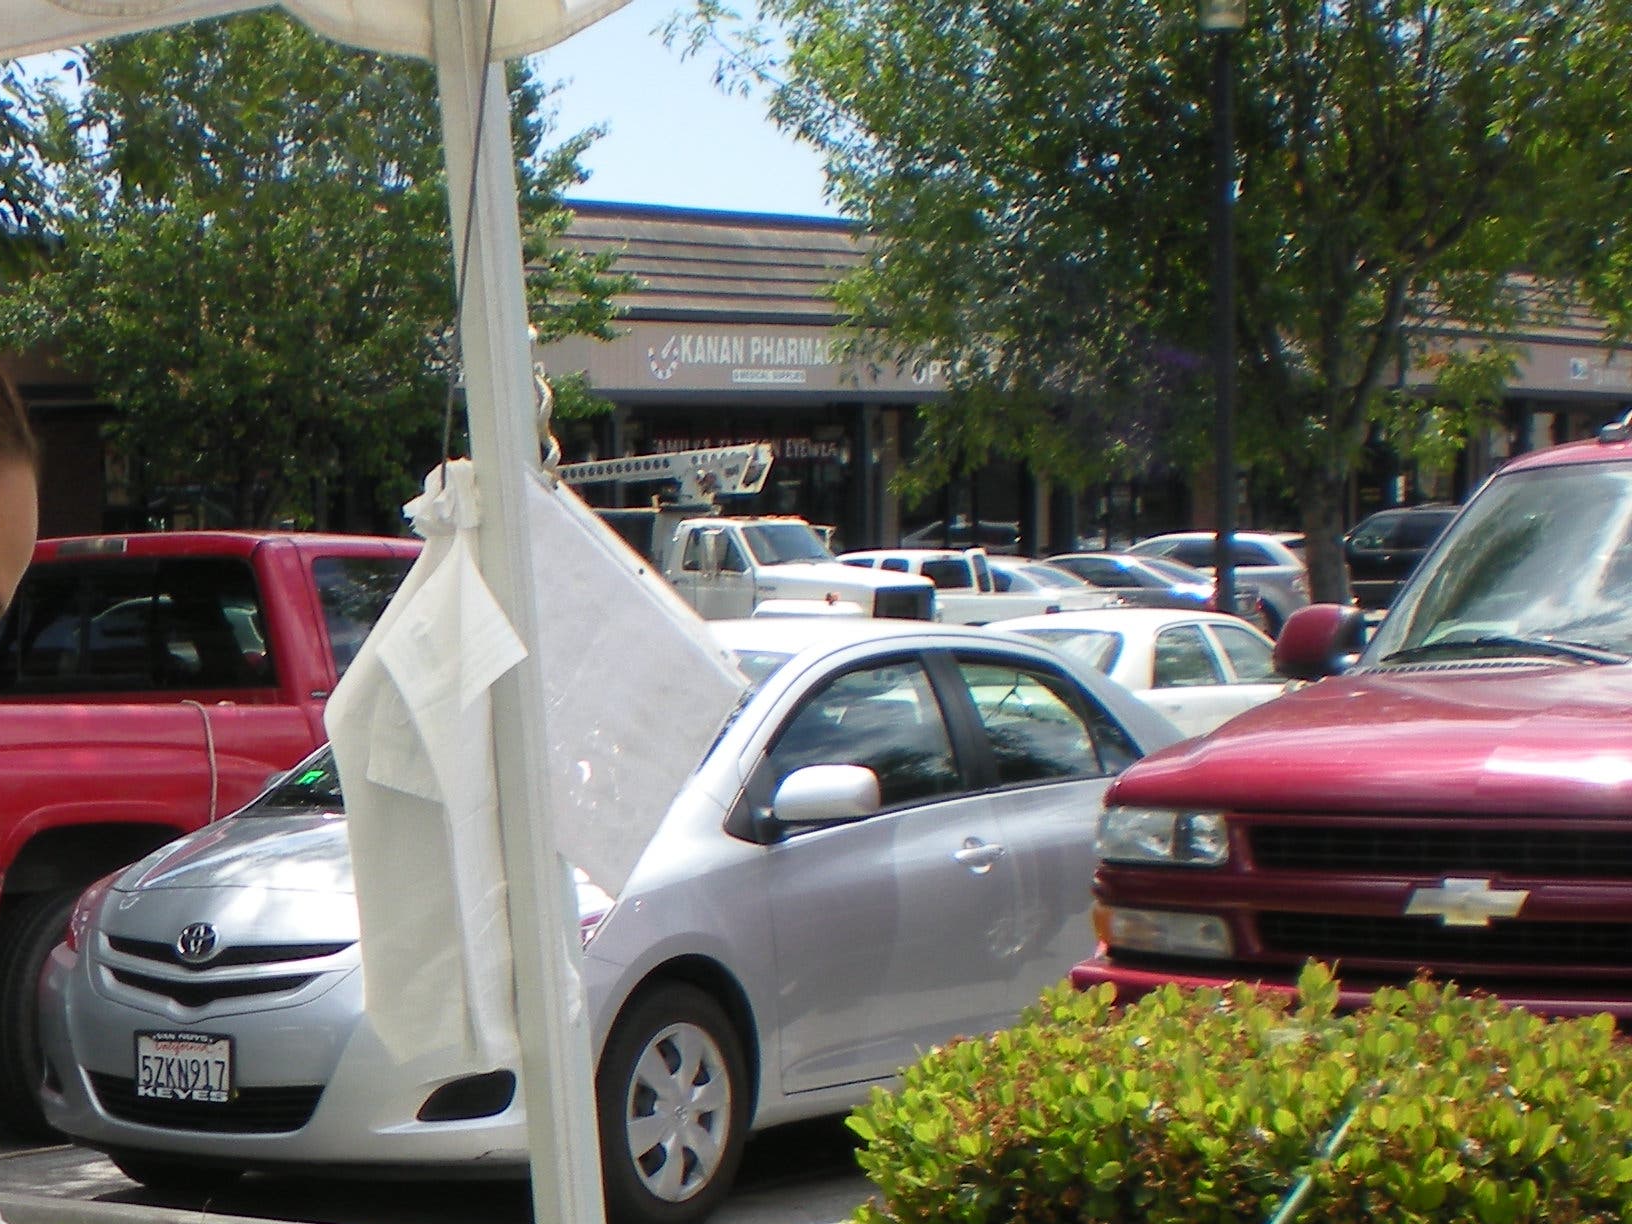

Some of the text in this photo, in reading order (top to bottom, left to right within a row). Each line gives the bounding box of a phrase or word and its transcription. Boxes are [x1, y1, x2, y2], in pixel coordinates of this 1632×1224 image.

[681, 335, 848, 366] KANAN PHARMAC
[142, 1055, 225, 1092] 5ZKN917
[137, 1085, 229, 1103] KEYES
